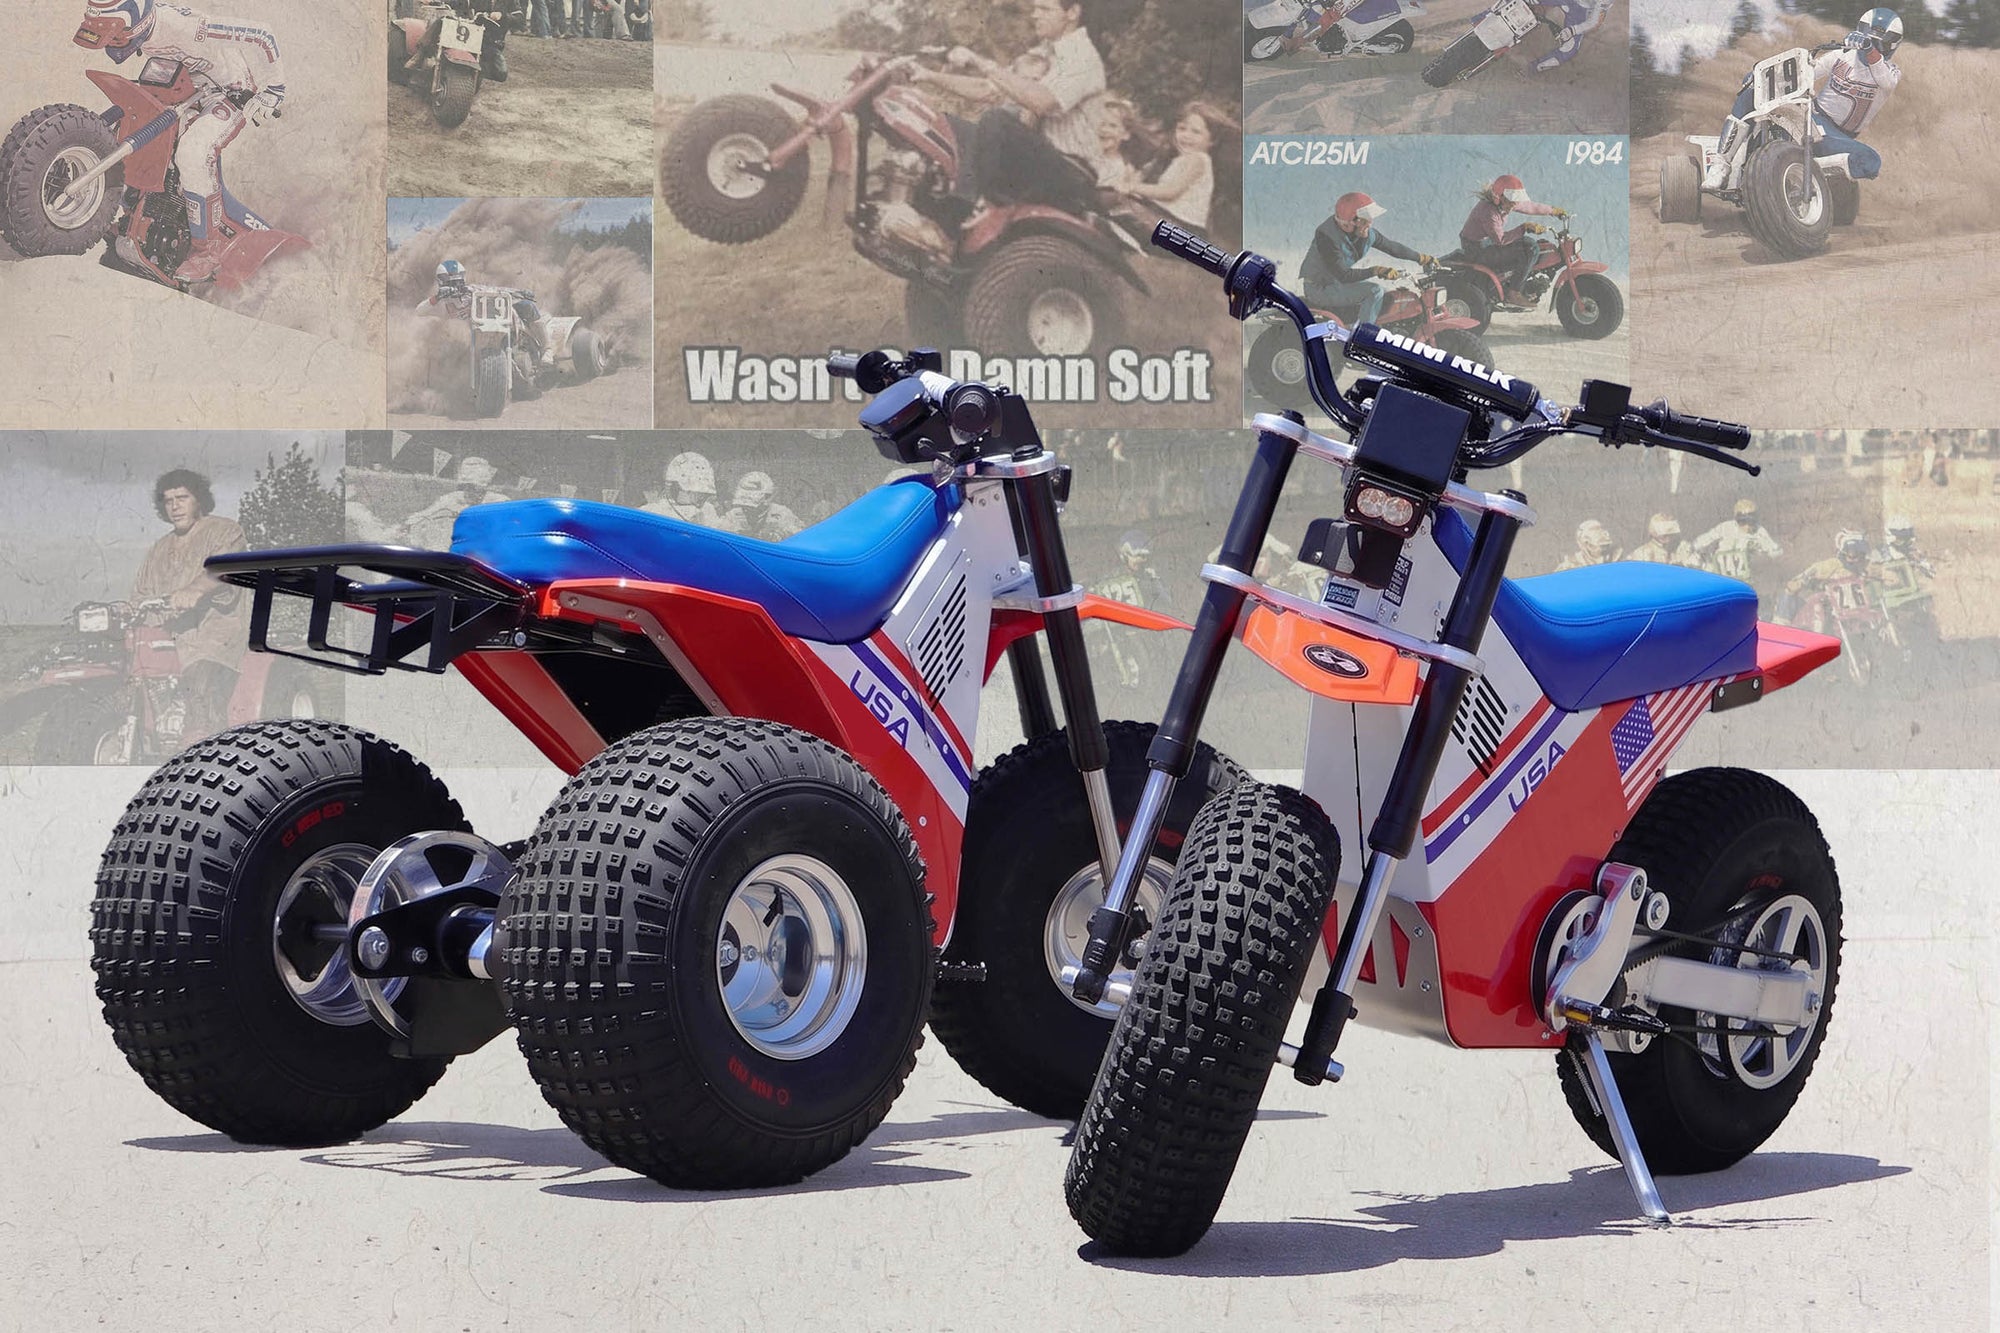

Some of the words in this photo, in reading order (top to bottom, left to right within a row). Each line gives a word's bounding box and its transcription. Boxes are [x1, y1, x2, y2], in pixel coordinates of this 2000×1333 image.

[456, 26, 470, 43] 9
[1765, 56, 1799, 101] 19
[1248, 140, 1370, 165] ATC125M
[1565, 140, 1623, 165] 1984
[479, 295, 507, 320] 19
[1450, 354, 1517, 392] KLK
[849, 669, 909, 749] USA
[1507, 740, 1567, 813] USA
